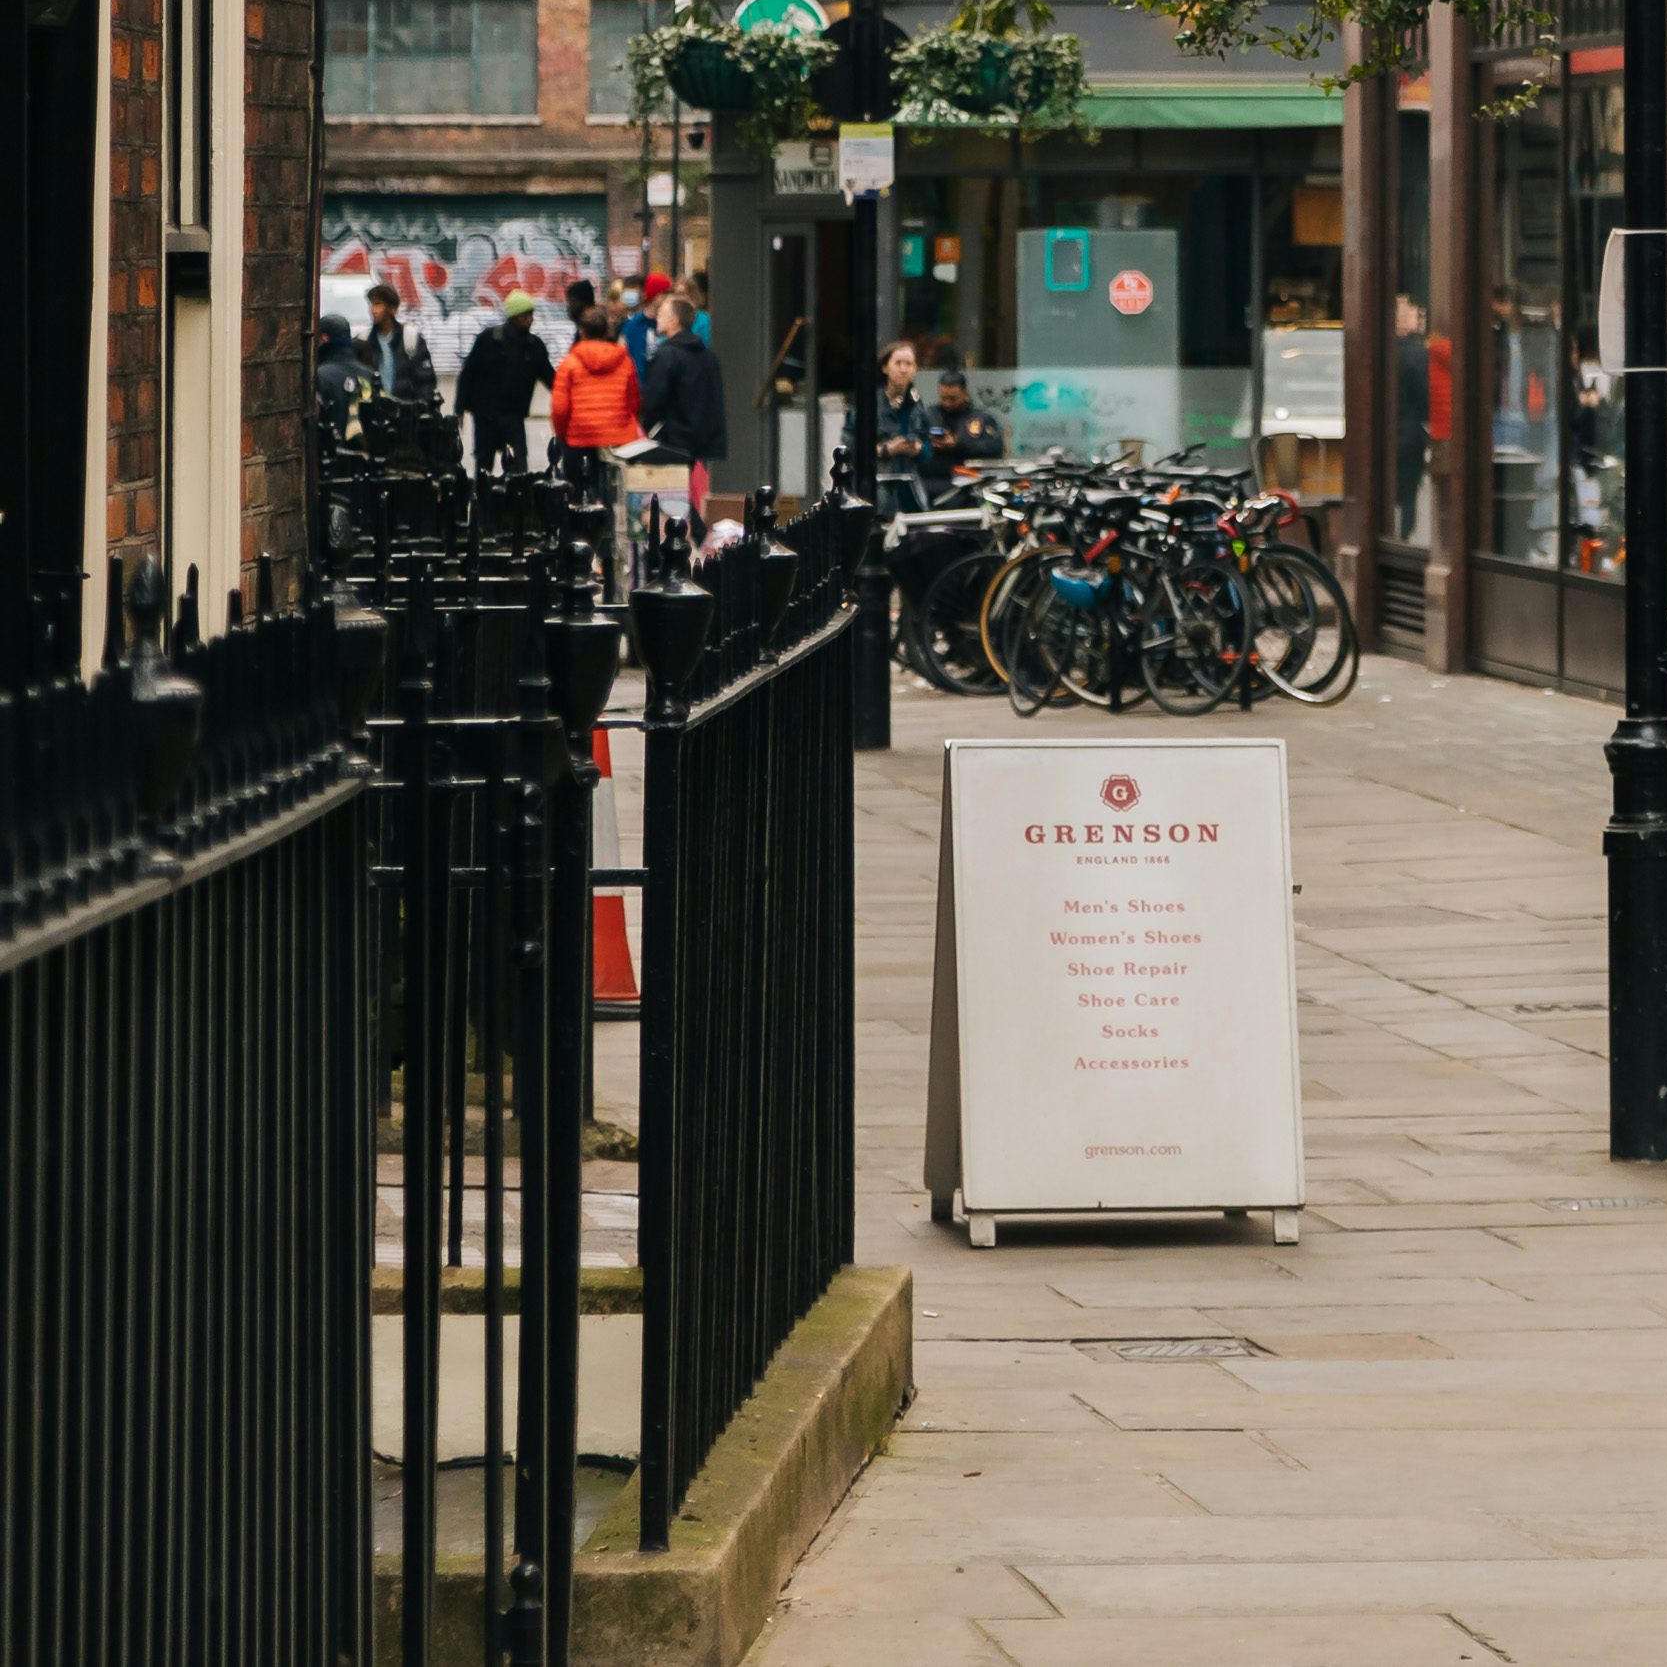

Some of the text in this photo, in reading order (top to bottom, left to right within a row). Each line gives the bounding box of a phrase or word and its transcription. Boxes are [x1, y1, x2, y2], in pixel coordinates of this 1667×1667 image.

[1111, 785, 1129, 801] G
[1024, 823, 1220, 844] GRENSON
[1076, 855, 1171, 865] ENGLAND 1866
[1063, 899, 1186, 914] Men's Shoes
[1050, 930, 1203, 946] Women's Shoes
[1067, 962, 1188, 978] Shoe Repair
[1077, 993, 1181, 1008] Shoe Care
[1101, 1024, 1160, 1039] Socks
[1074, 1056, 1190, 1070] Accessories
[1084, 1143, 1183, 1159] grenson.com
